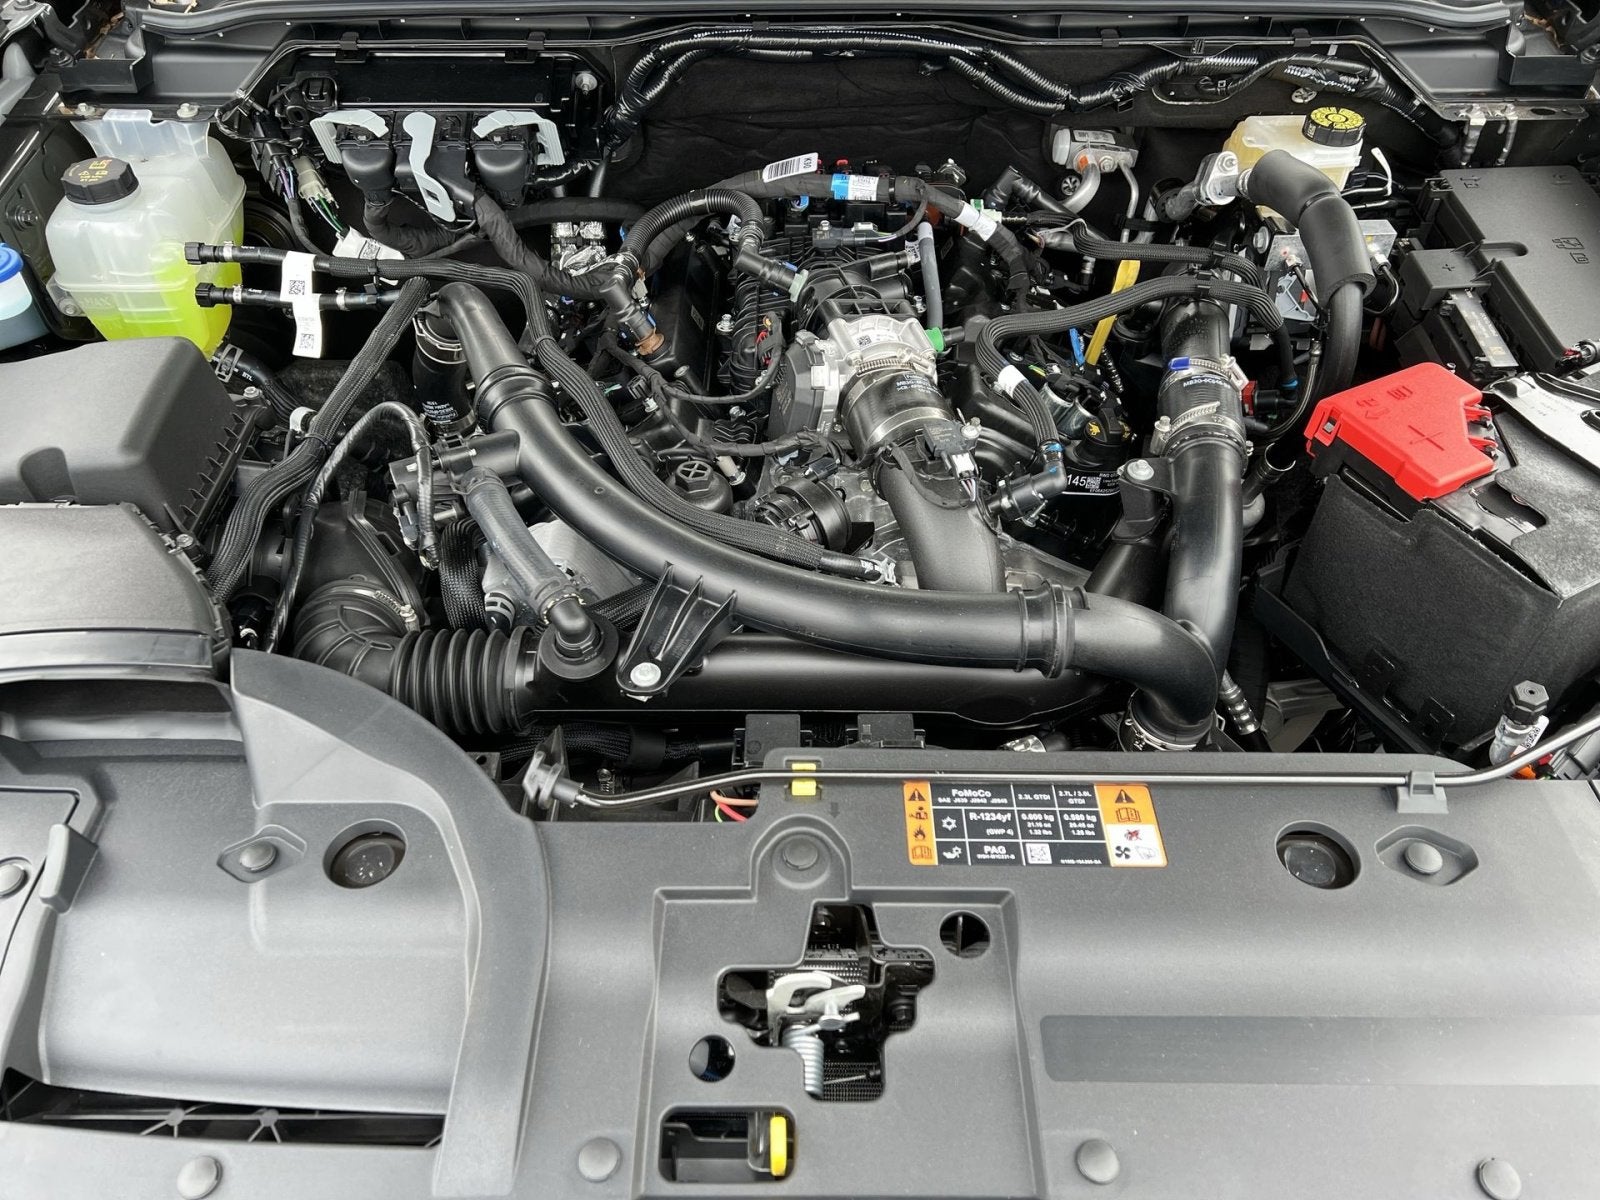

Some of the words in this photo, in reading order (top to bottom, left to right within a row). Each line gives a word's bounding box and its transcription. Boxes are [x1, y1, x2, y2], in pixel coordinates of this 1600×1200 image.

[1067, 474, 1087, 487] 145
[951, 789, 992, 798] FoMoCo
[969, 812, 1012, 823] R-1234yf
[983, 845, 1007, 854] PAG
